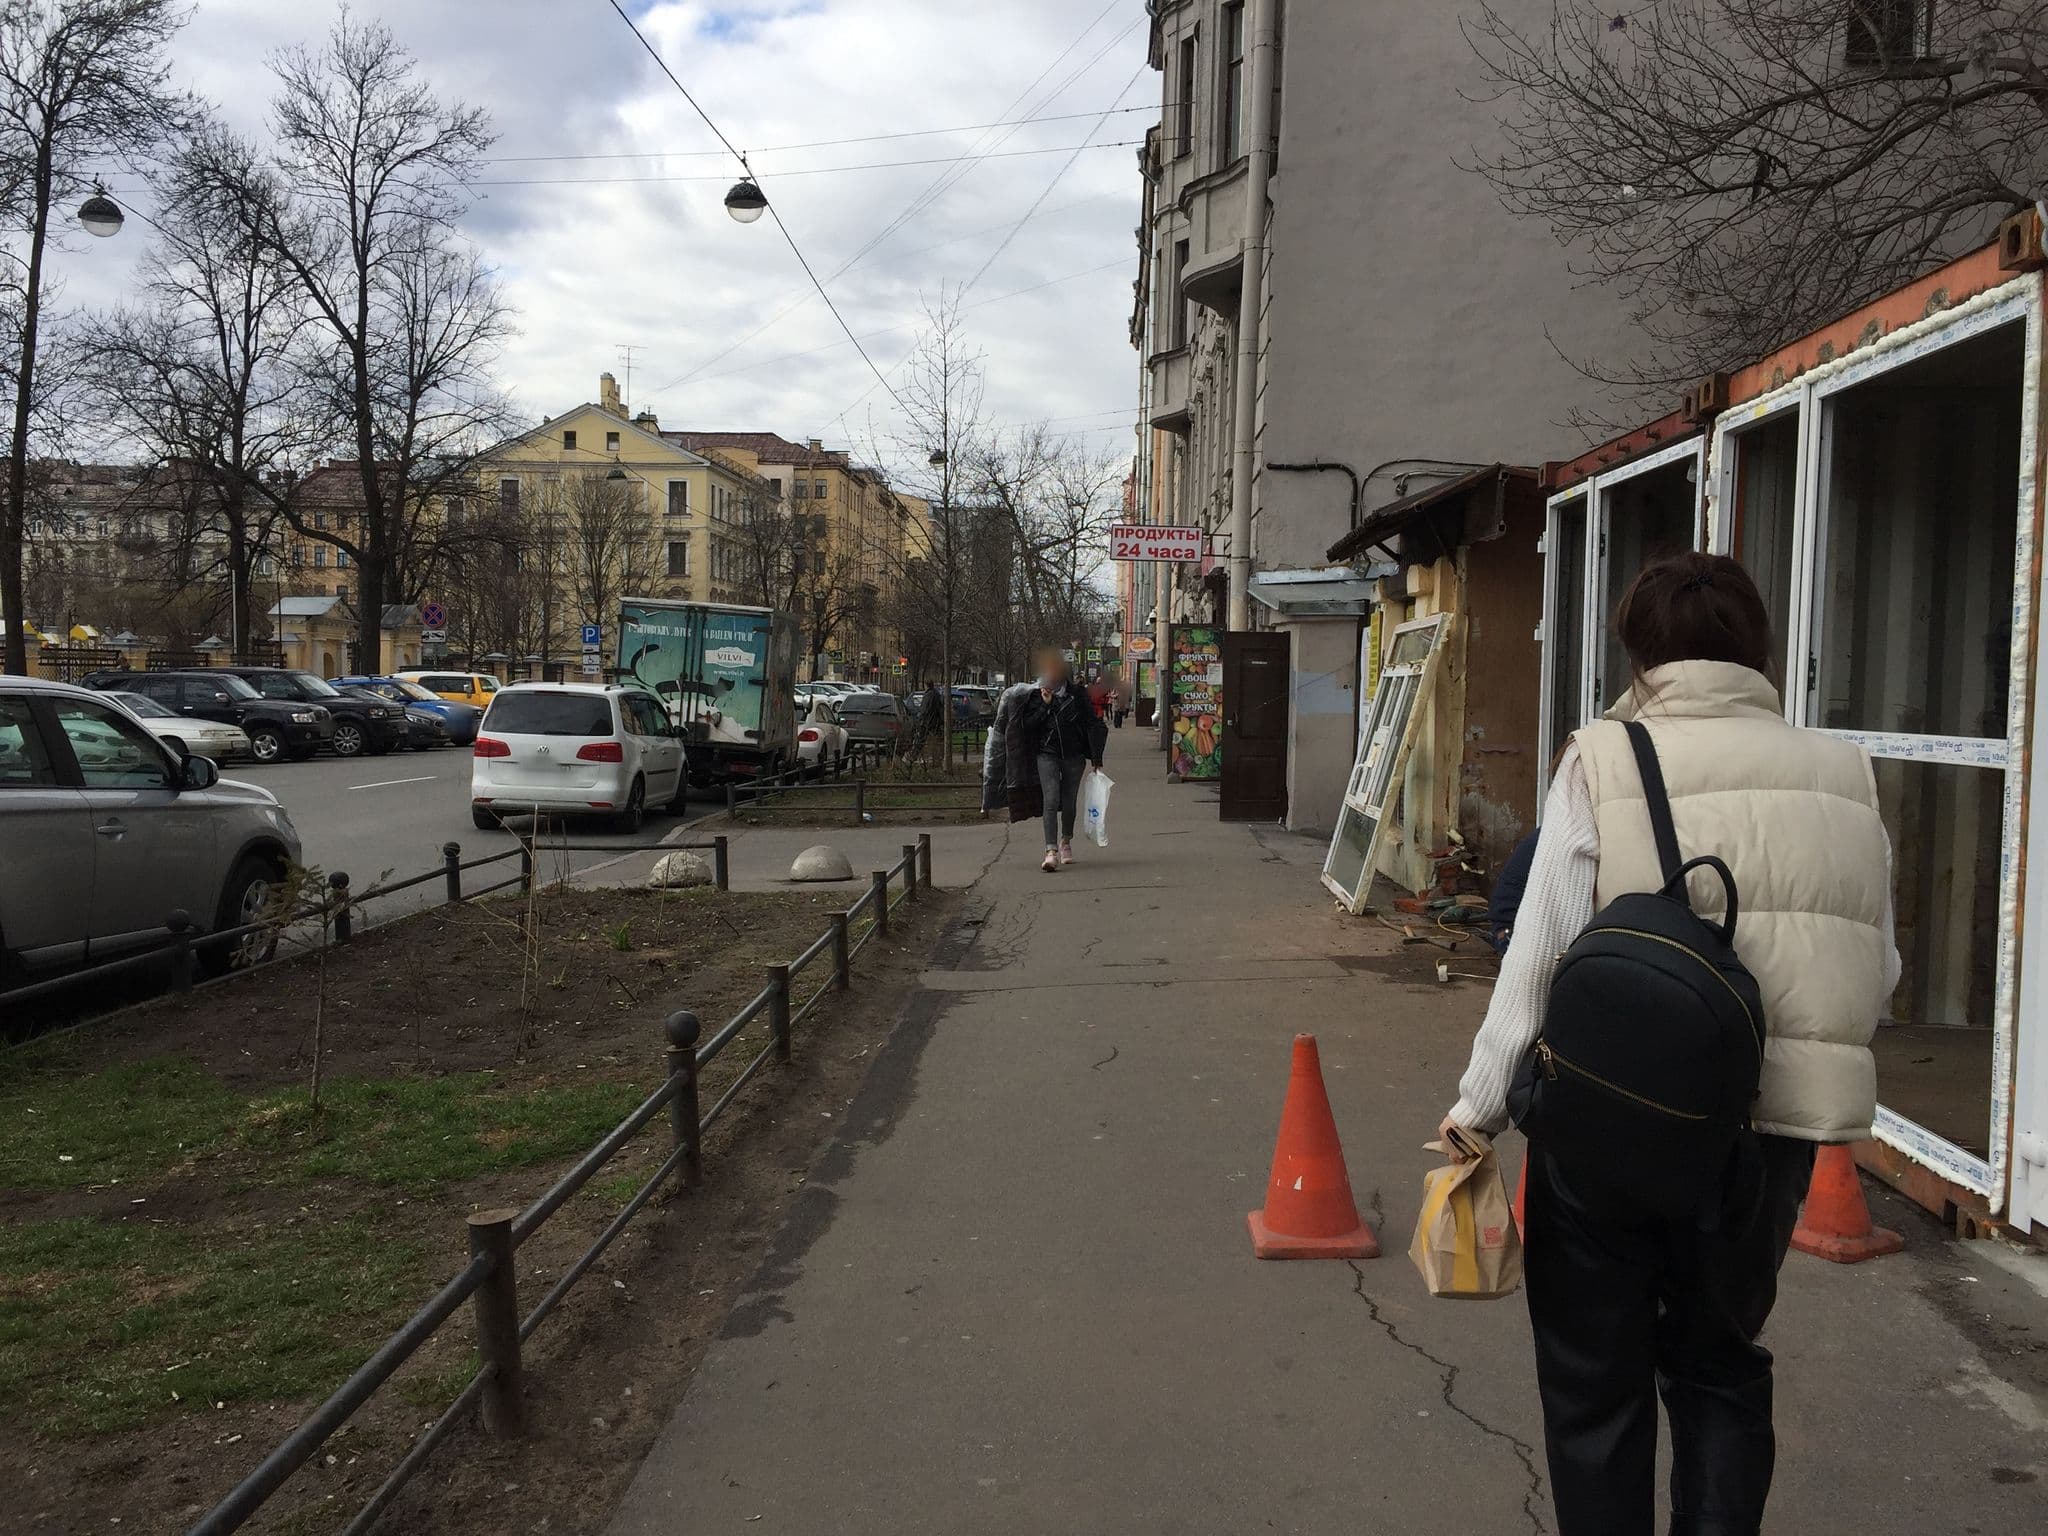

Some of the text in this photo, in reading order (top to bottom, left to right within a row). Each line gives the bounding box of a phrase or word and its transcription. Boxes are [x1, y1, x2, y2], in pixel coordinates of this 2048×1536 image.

[1114, 527, 1200, 541] ПРОДУКТЫ
[1117, 542, 1196, 560] 24 часа
[585, 628, 596, 642] P
[717, 652, 743, 662] VILVI
[1178, 653, 1218, 662] ФРУКТЫ
[1183, 691, 1209, 700] СУХО
